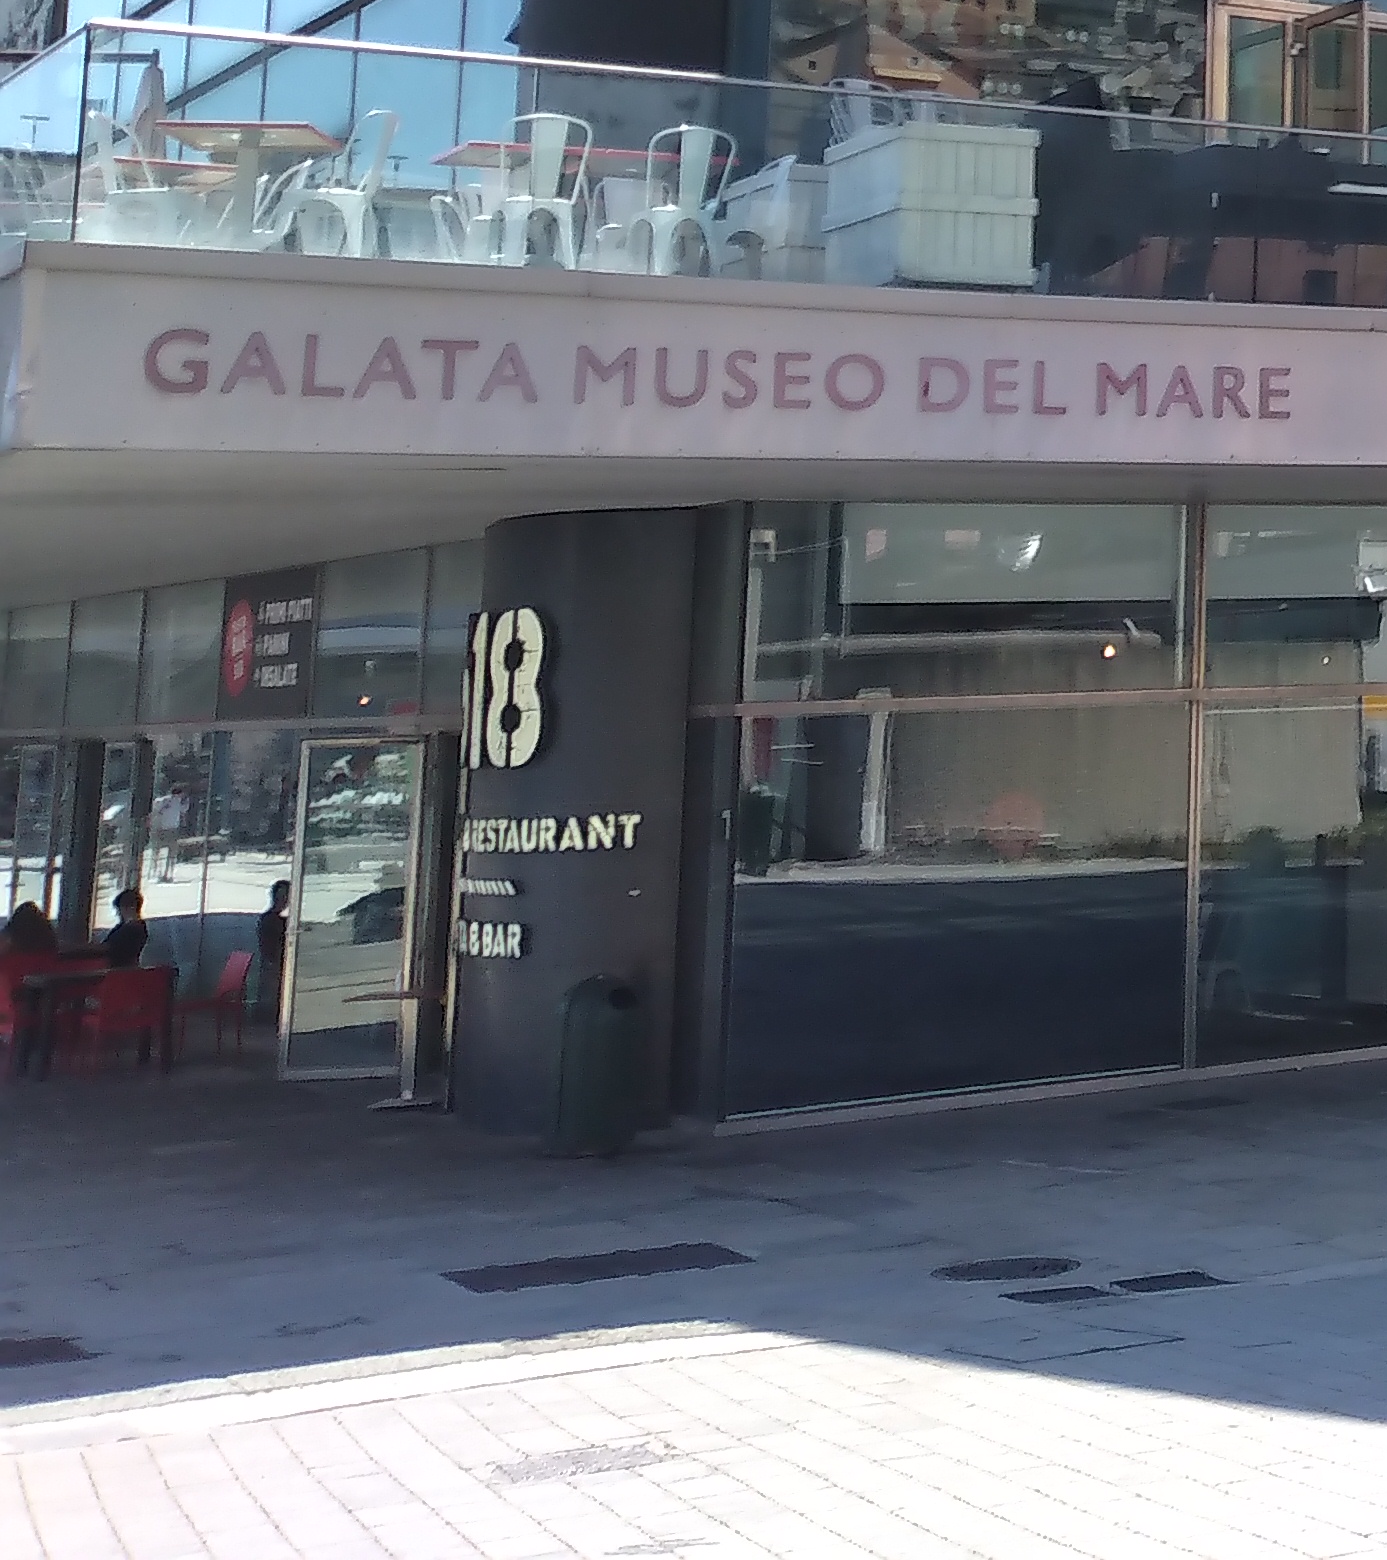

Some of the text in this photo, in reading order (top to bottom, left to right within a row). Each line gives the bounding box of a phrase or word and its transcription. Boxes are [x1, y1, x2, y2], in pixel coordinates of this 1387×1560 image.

[143, 327, 1292, 419] GALATA MUSEO DEL MARE
